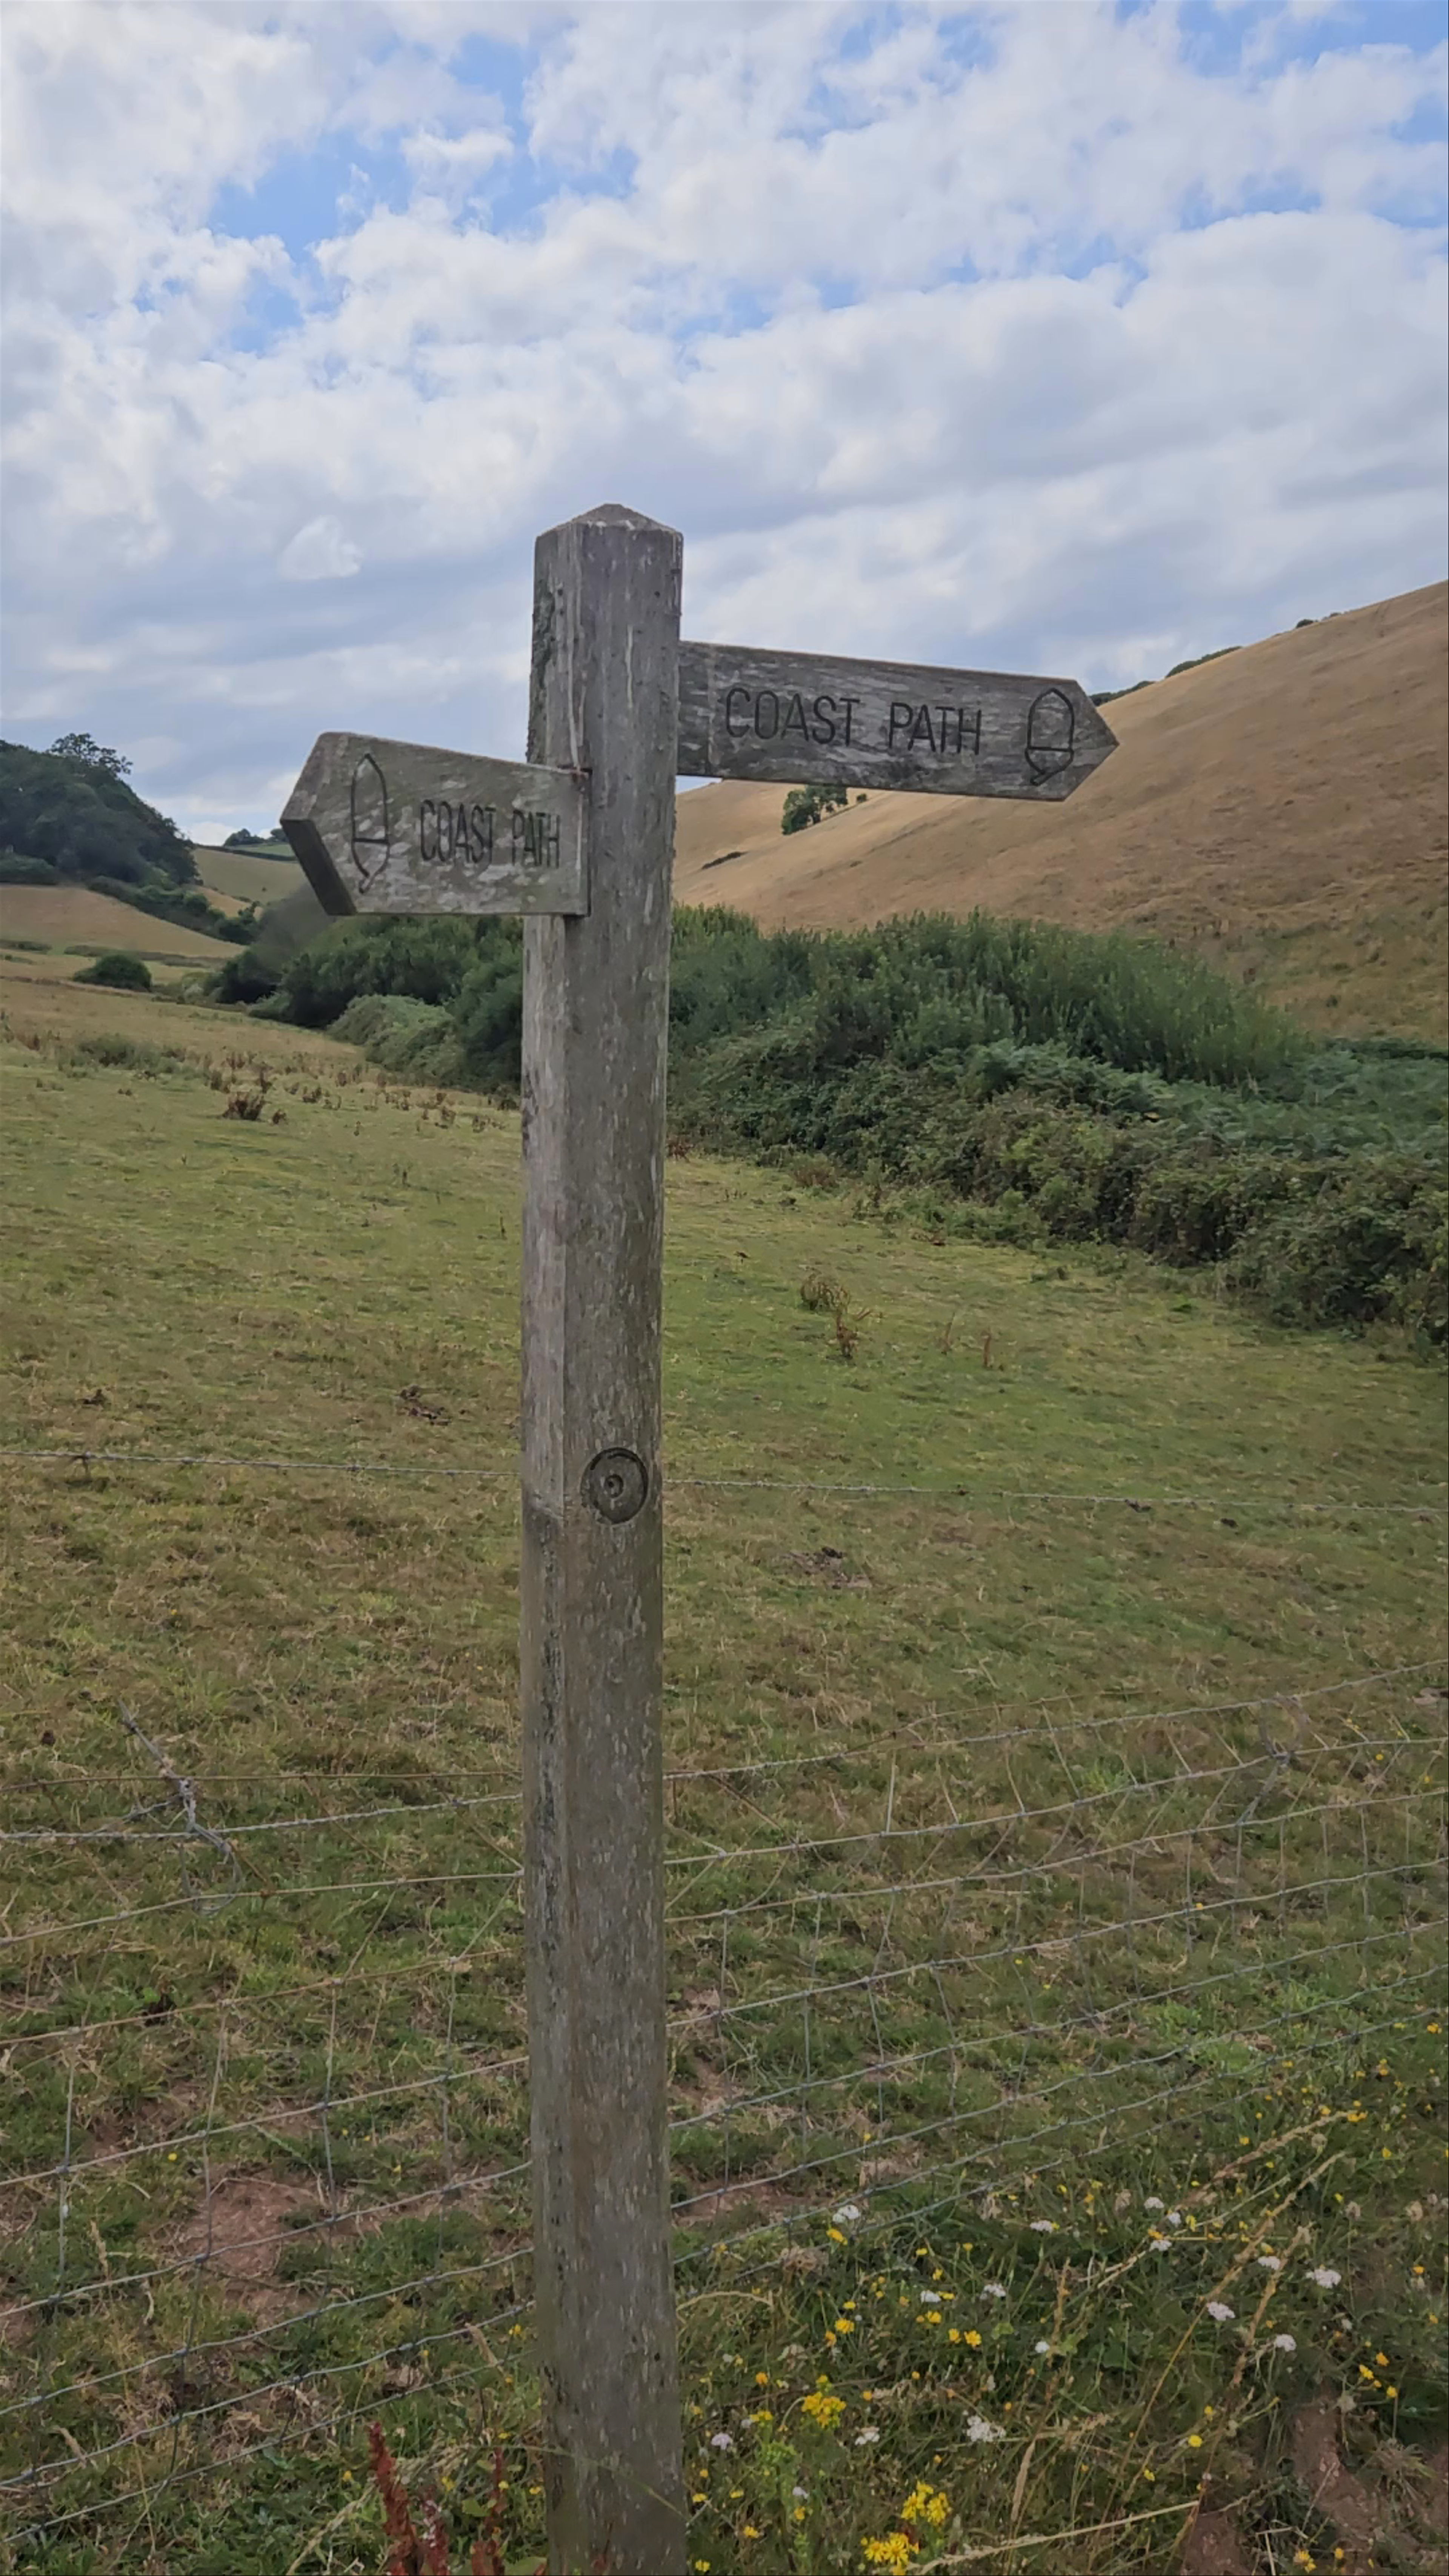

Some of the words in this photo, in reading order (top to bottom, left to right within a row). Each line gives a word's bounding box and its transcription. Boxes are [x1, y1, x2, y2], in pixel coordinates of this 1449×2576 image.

[724, 687, 860, 746] COAST
[887, 702, 981, 755] PATH
[420, 799, 496, 864] COAST
[512, 809, 560, 869] PATH
